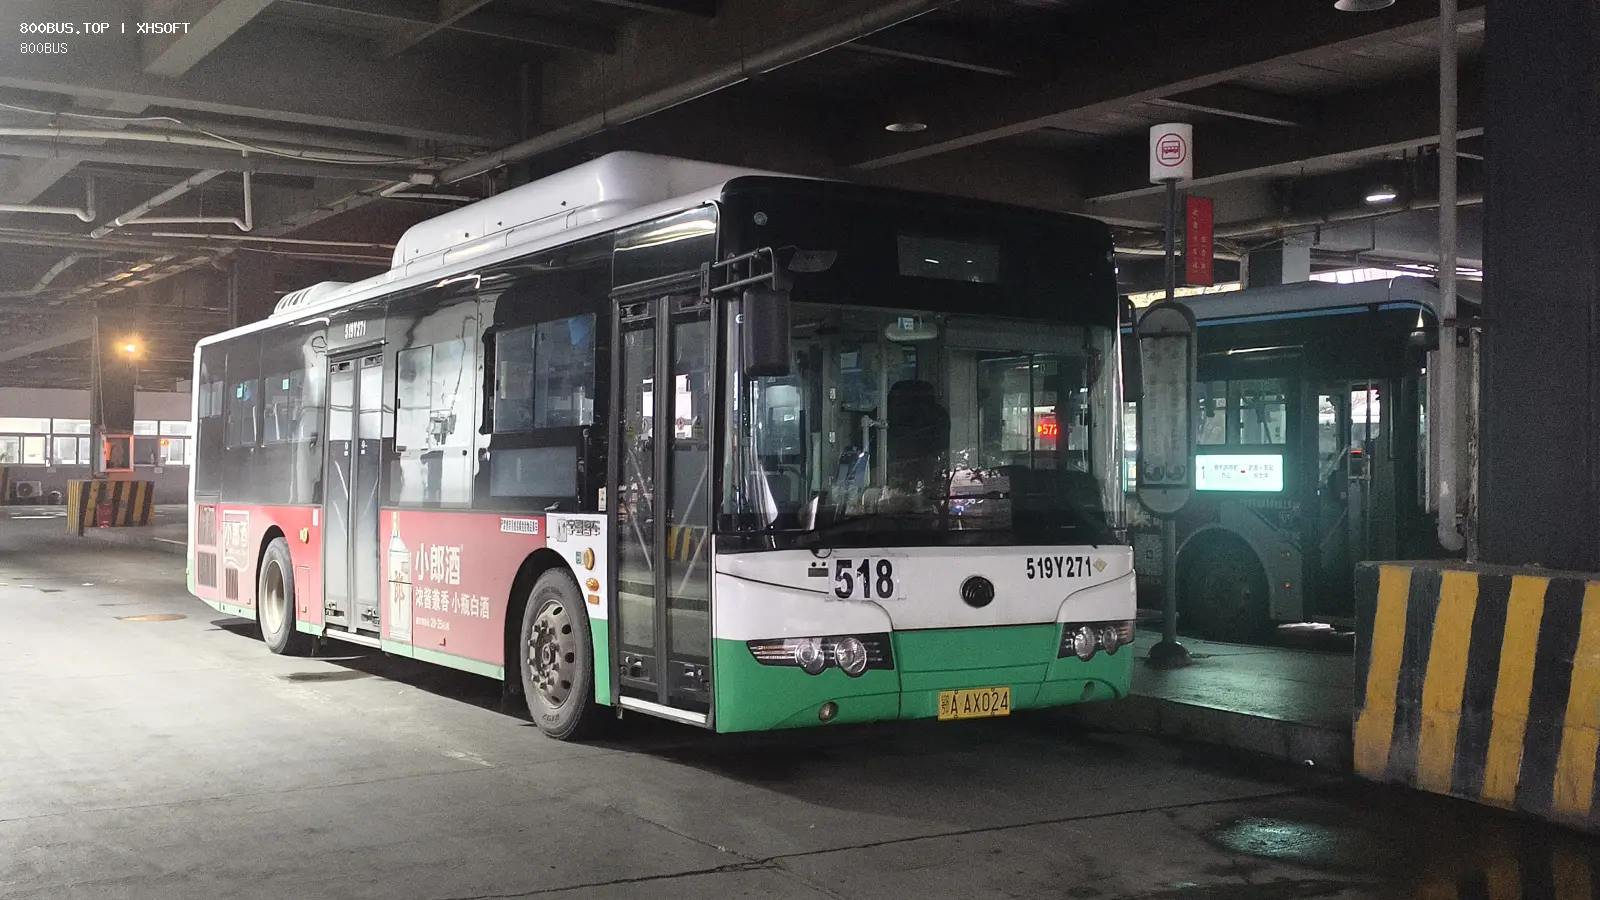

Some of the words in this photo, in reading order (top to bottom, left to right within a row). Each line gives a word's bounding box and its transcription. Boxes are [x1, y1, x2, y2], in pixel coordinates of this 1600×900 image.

[415, 542, 461, 585] 小郎酒
[1026, 555, 1092, 580] 519Y271
[834, 558, 894, 599] 518
[451, 591, 490, 620] 小瓶白酒
[963, 690, 1009, 714] AX024
